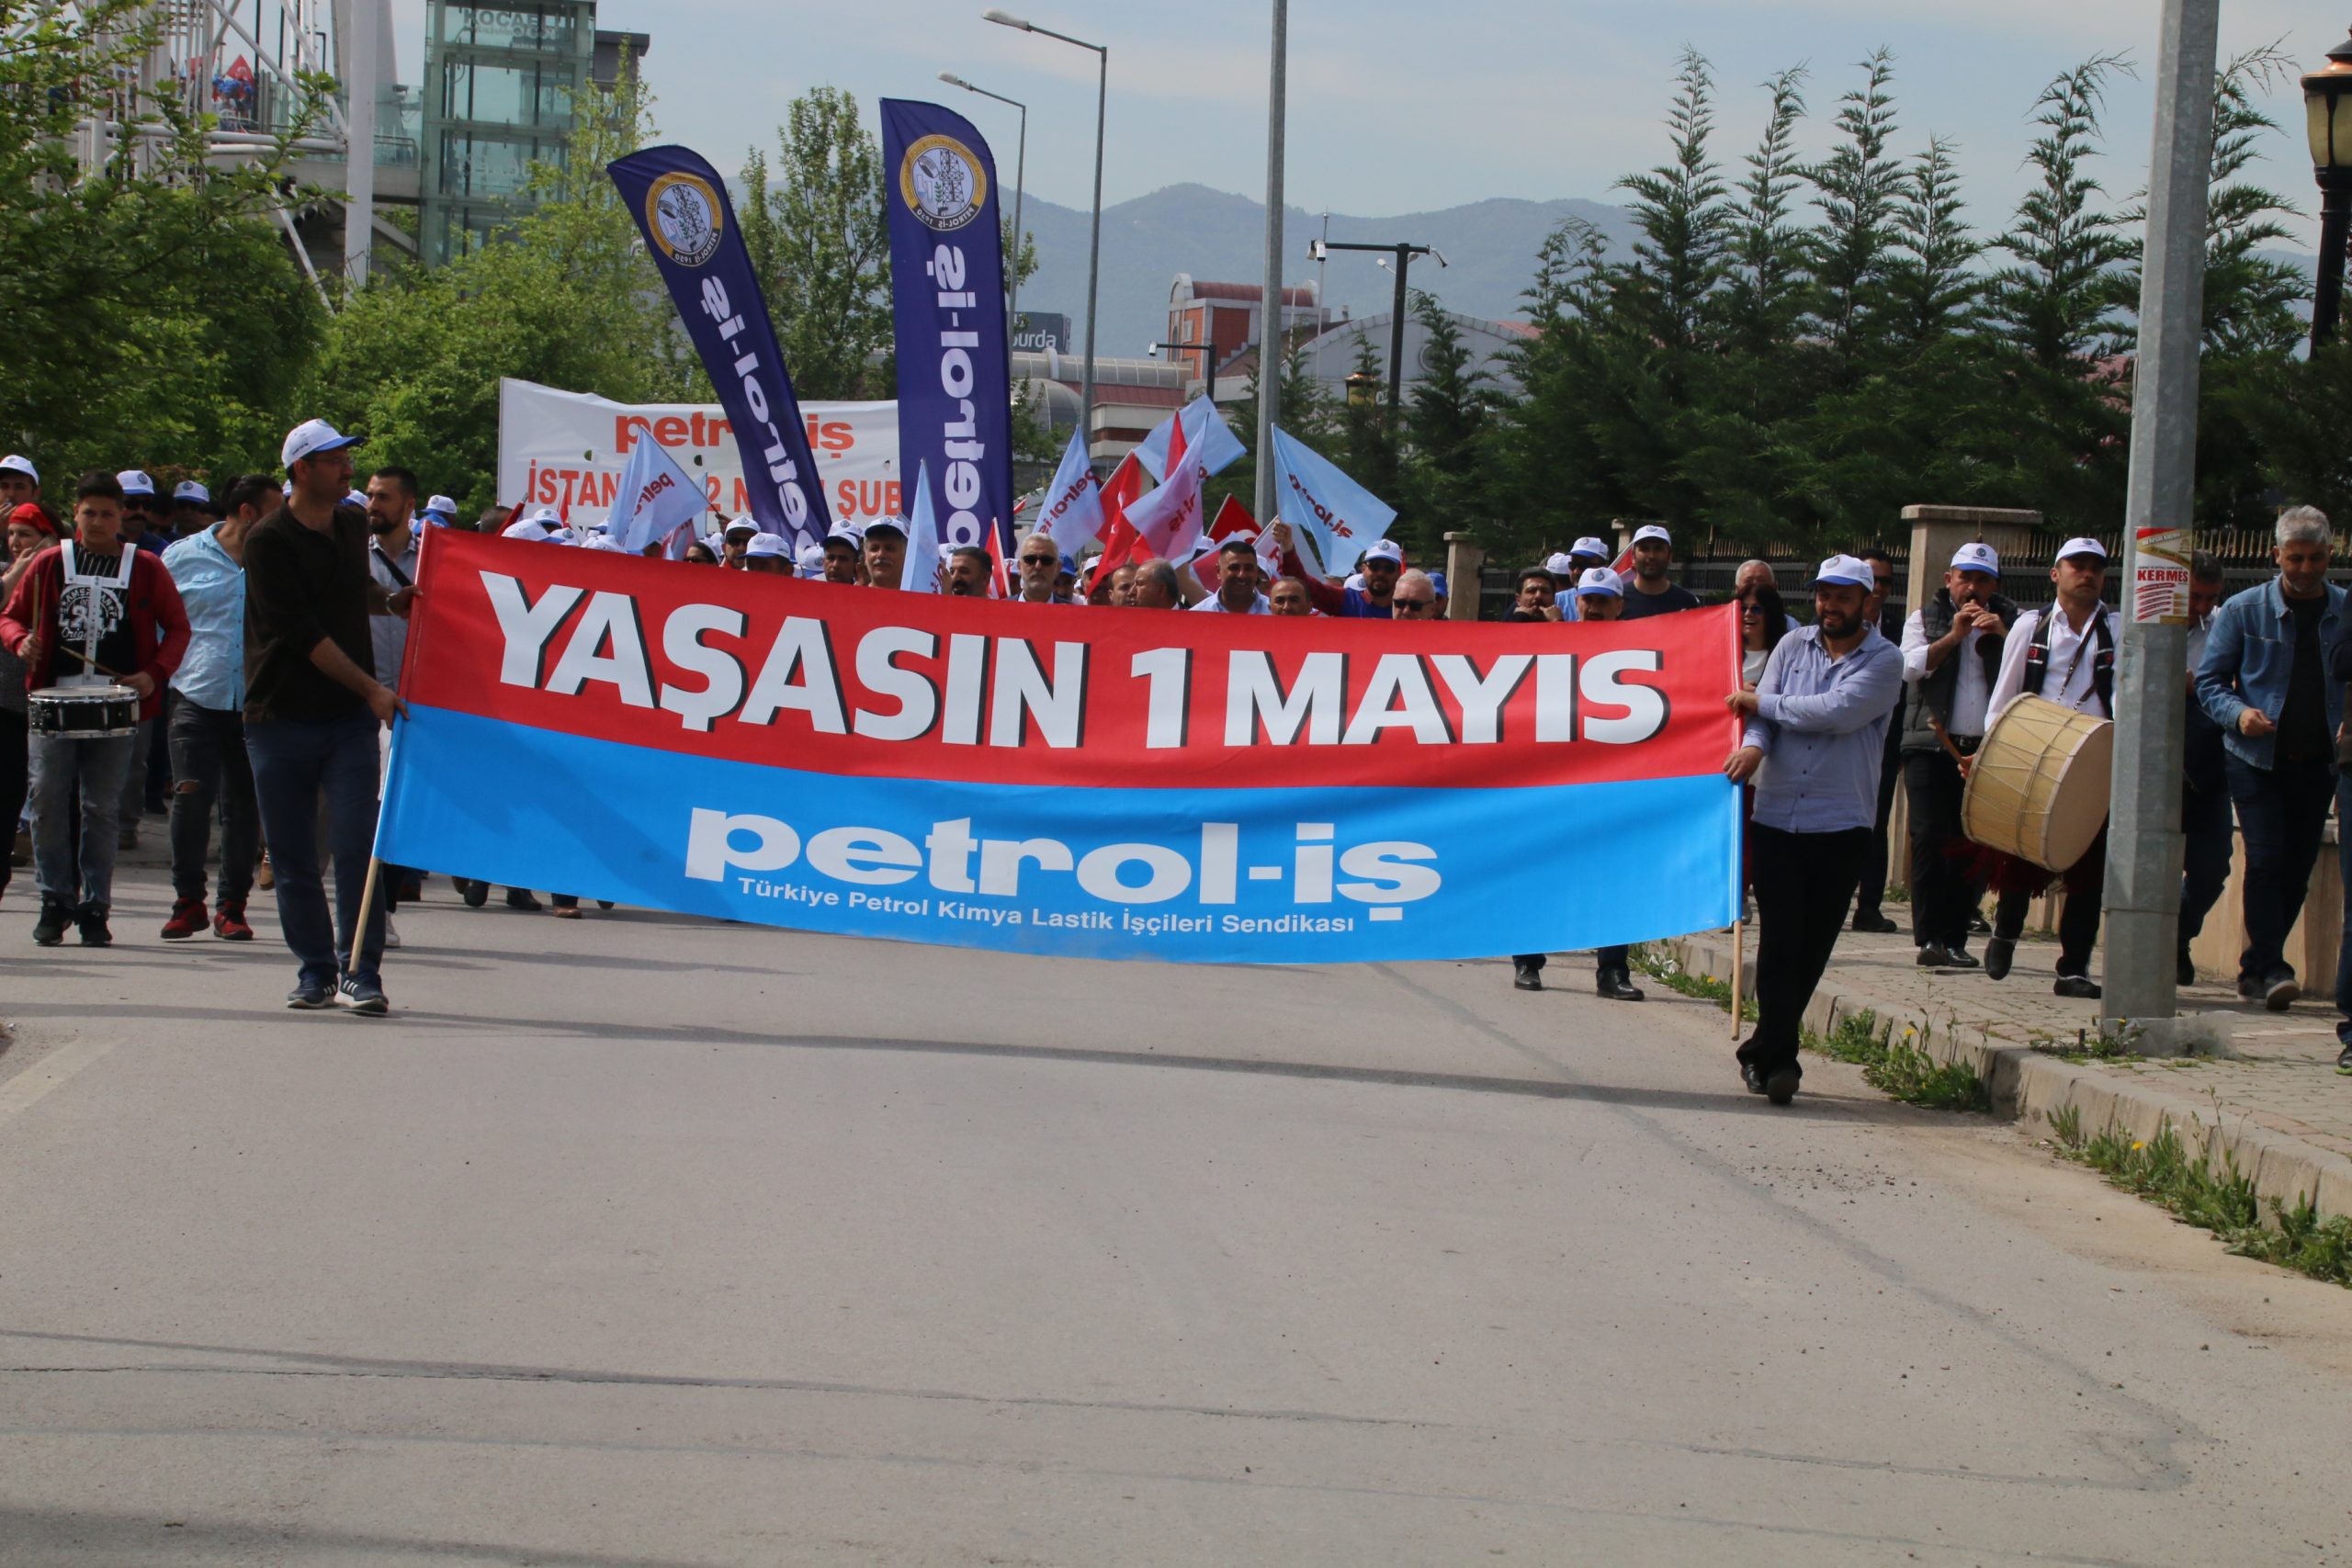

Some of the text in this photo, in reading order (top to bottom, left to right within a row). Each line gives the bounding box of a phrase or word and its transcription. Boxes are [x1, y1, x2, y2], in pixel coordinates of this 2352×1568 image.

[527, 459, 622, 508] İSTAN
[707, 476, 721, 512] 2
[2137, 570, 2188, 582] KERMES
[479, 570, 1670, 749] YAŞASIN 1 MAYIS
[684, 807, 1442, 921] petrol-iş
[738, 876, 1354, 936] Türkiye Petrol Kimya Lastik İşçileri Sendikası
